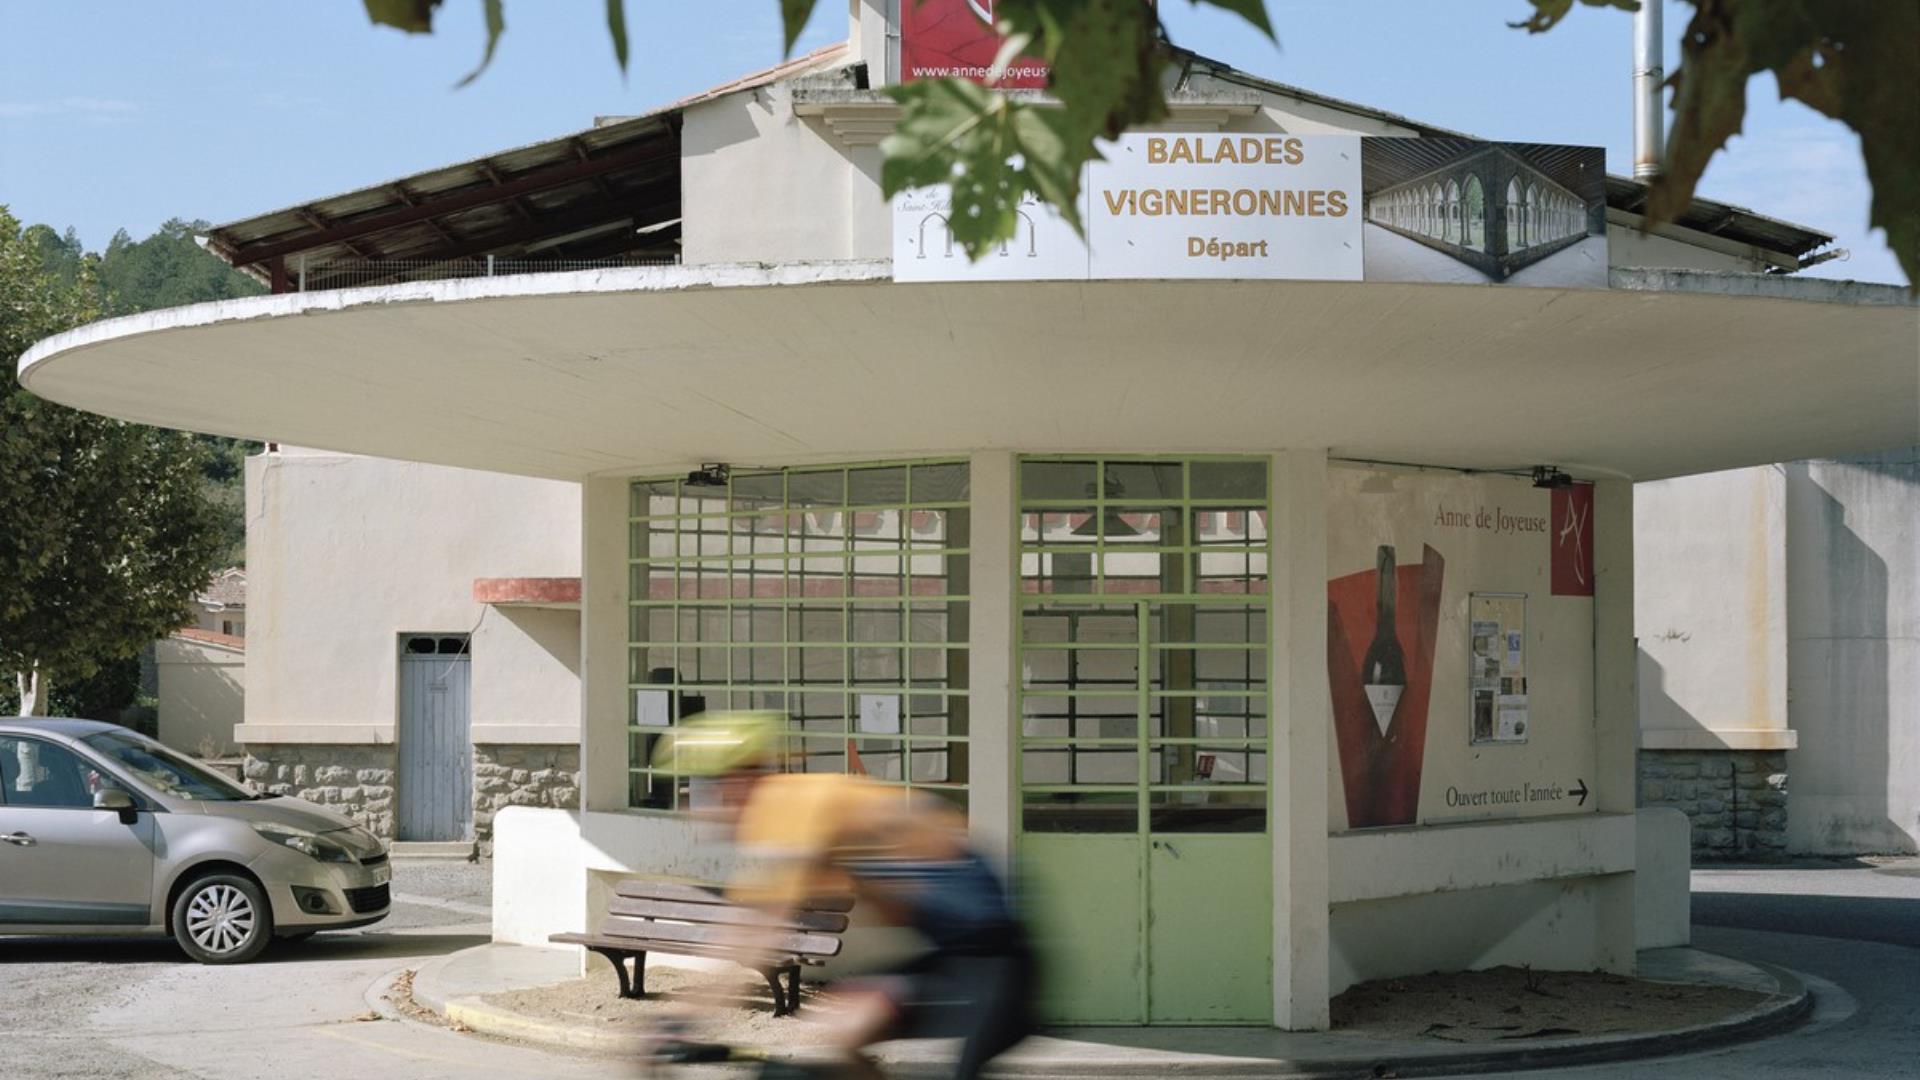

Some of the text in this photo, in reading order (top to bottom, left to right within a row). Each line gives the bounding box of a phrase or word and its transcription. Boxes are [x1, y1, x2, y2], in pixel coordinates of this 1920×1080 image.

[1147, 137, 1304, 165] BALADES
[1103, 189, 1348, 217] VIGNERONNES
[1187, 236, 1268, 261] Départ
[1434, 503, 1546, 535] Anne de Joyeuse
[1445, 781, 1563, 808] Ouvert toute l'année
